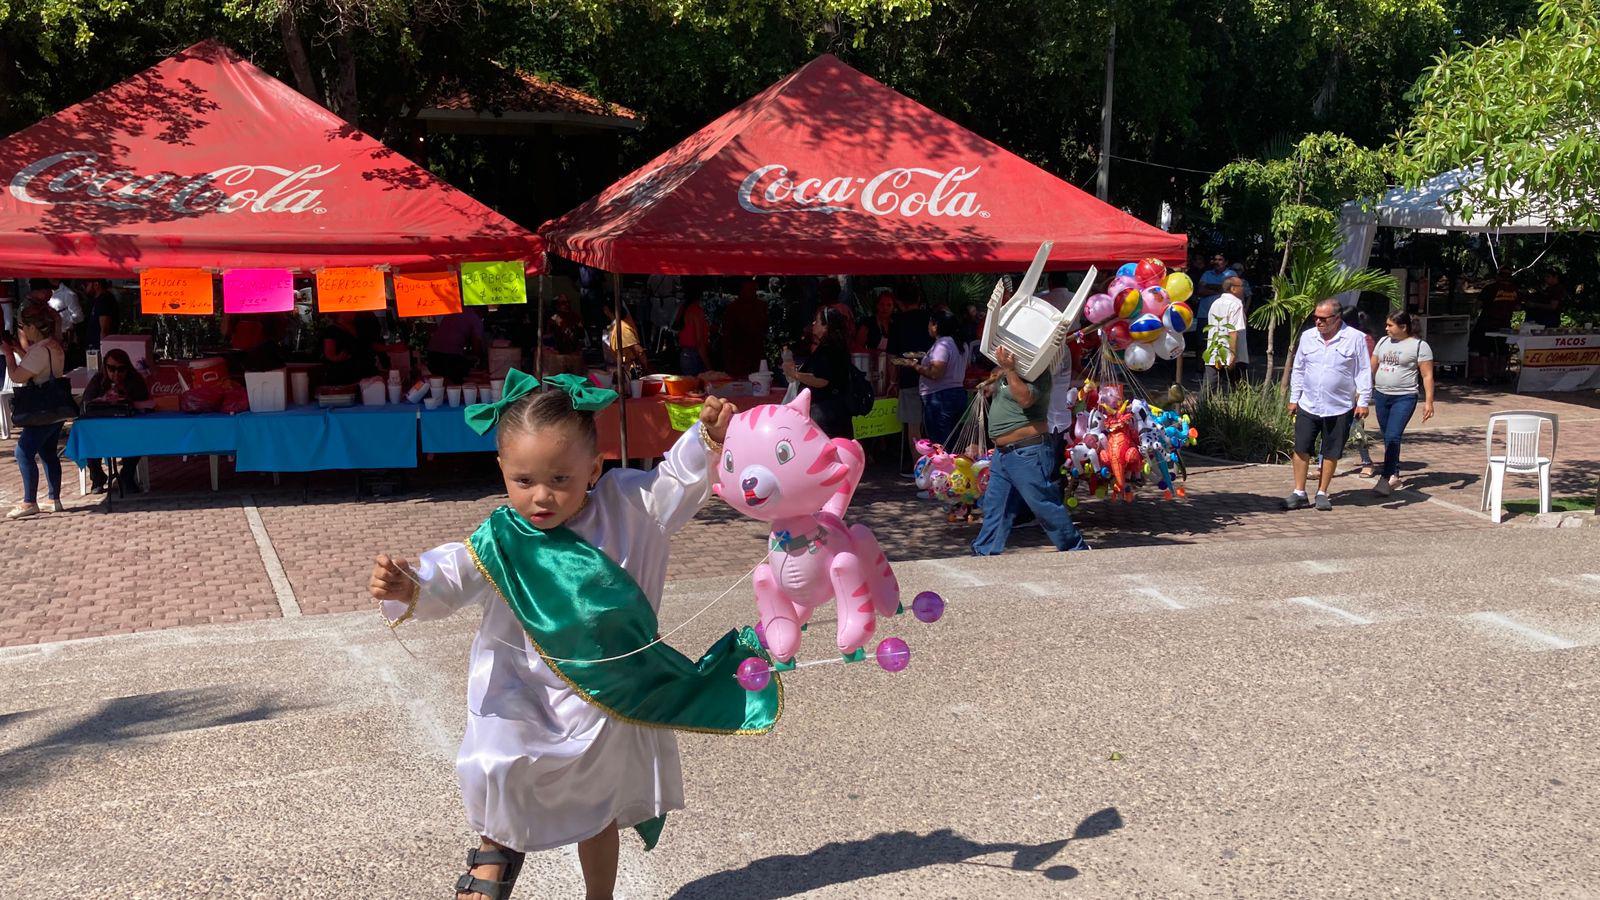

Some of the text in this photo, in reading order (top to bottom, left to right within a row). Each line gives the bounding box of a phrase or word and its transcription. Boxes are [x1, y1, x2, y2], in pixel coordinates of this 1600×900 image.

[10, 151, 340, 213] Coca-Cola
[738, 164, 981, 217] Coca-Cola
[1529, 352, 1543, 363] EL
[1555, 337, 1587, 346] TACOS
